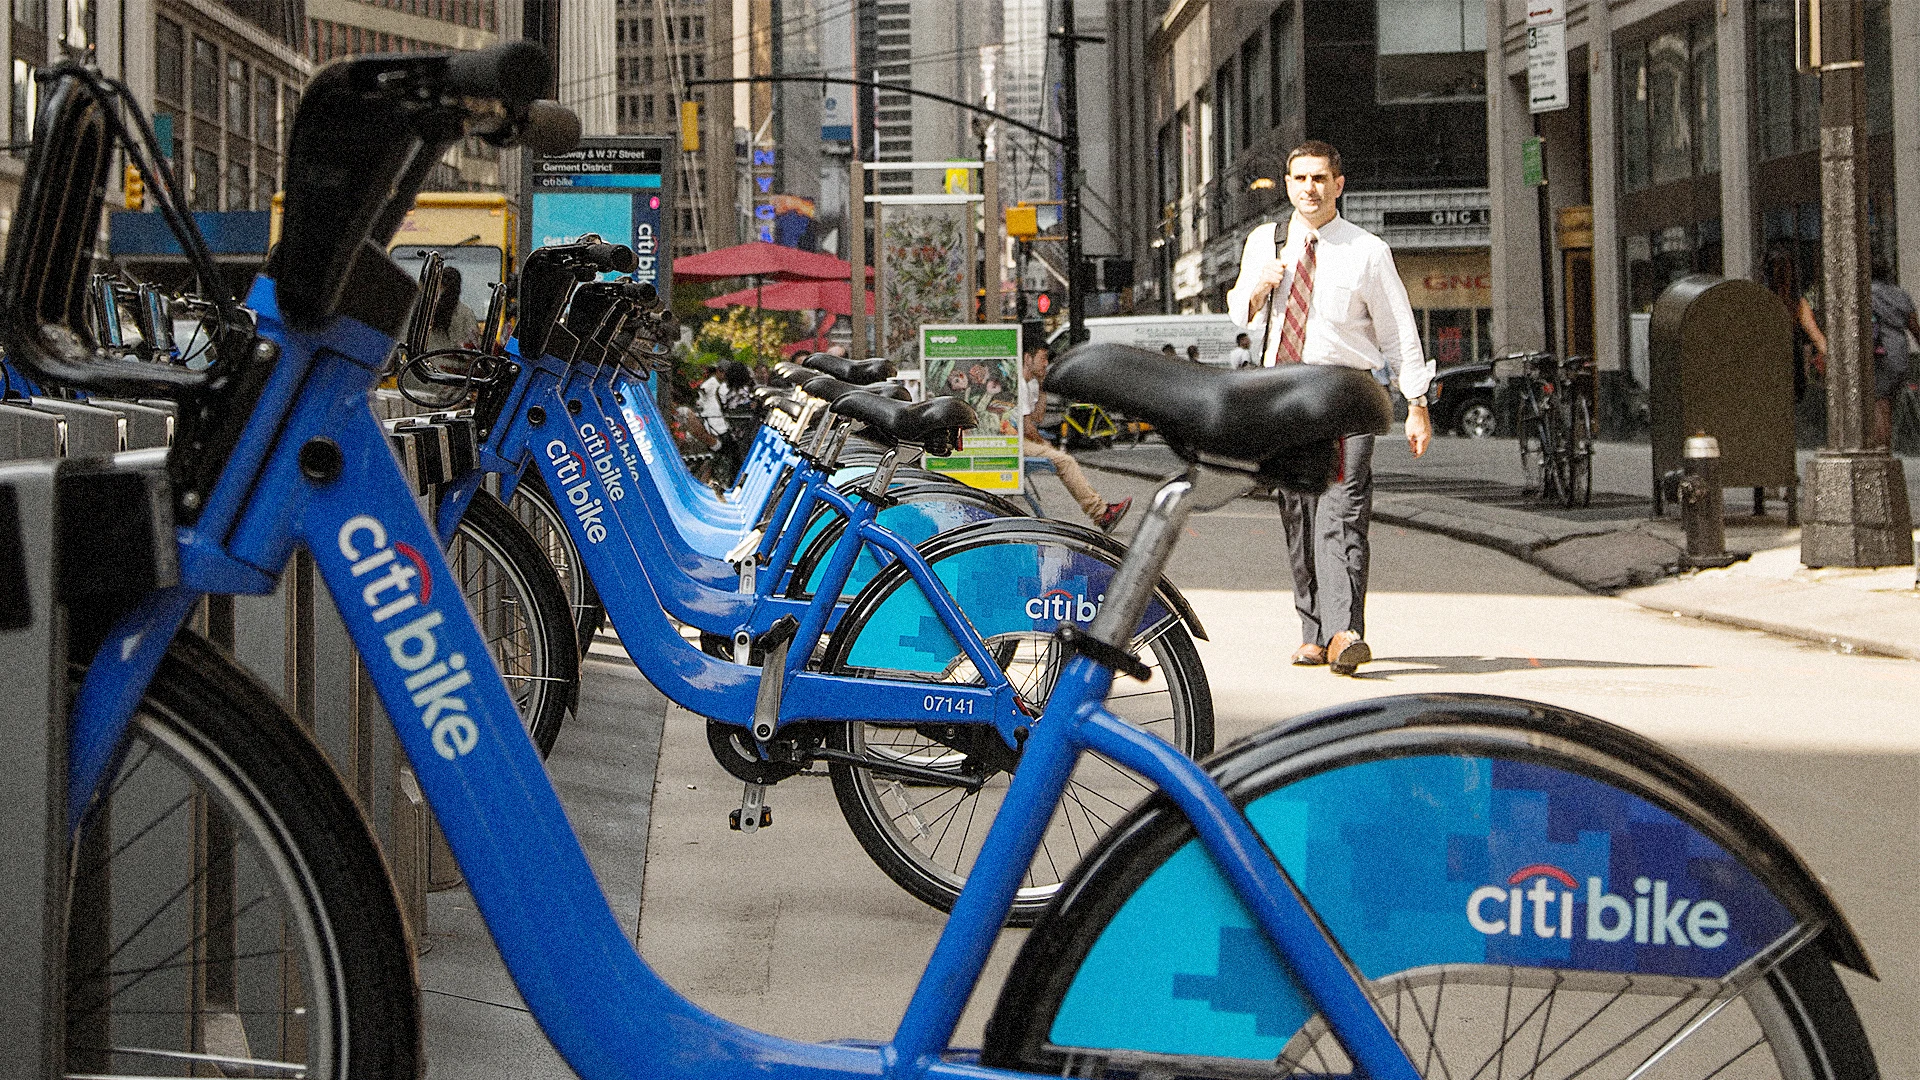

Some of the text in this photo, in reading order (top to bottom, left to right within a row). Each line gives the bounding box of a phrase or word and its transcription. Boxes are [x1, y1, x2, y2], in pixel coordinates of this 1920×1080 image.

[542, 163, 613, 172] Garment District
[588, 150, 594, 159] &
[596, 150, 606, 159] W
[606, 150, 618, 159] 37
[618, 150, 645, 159] Street
[1431, 210, 1471, 225] GNC
[637, 223, 659, 255] citi
[580, 423, 625, 502] citi bike
[546, 440, 607, 544] citi bike
[1025, 589, 1073, 621] citi
[338, 514, 479, 761] citi bike
[923, 695, 973, 715] 07141
[1466, 864, 1729, 949] citi bike
